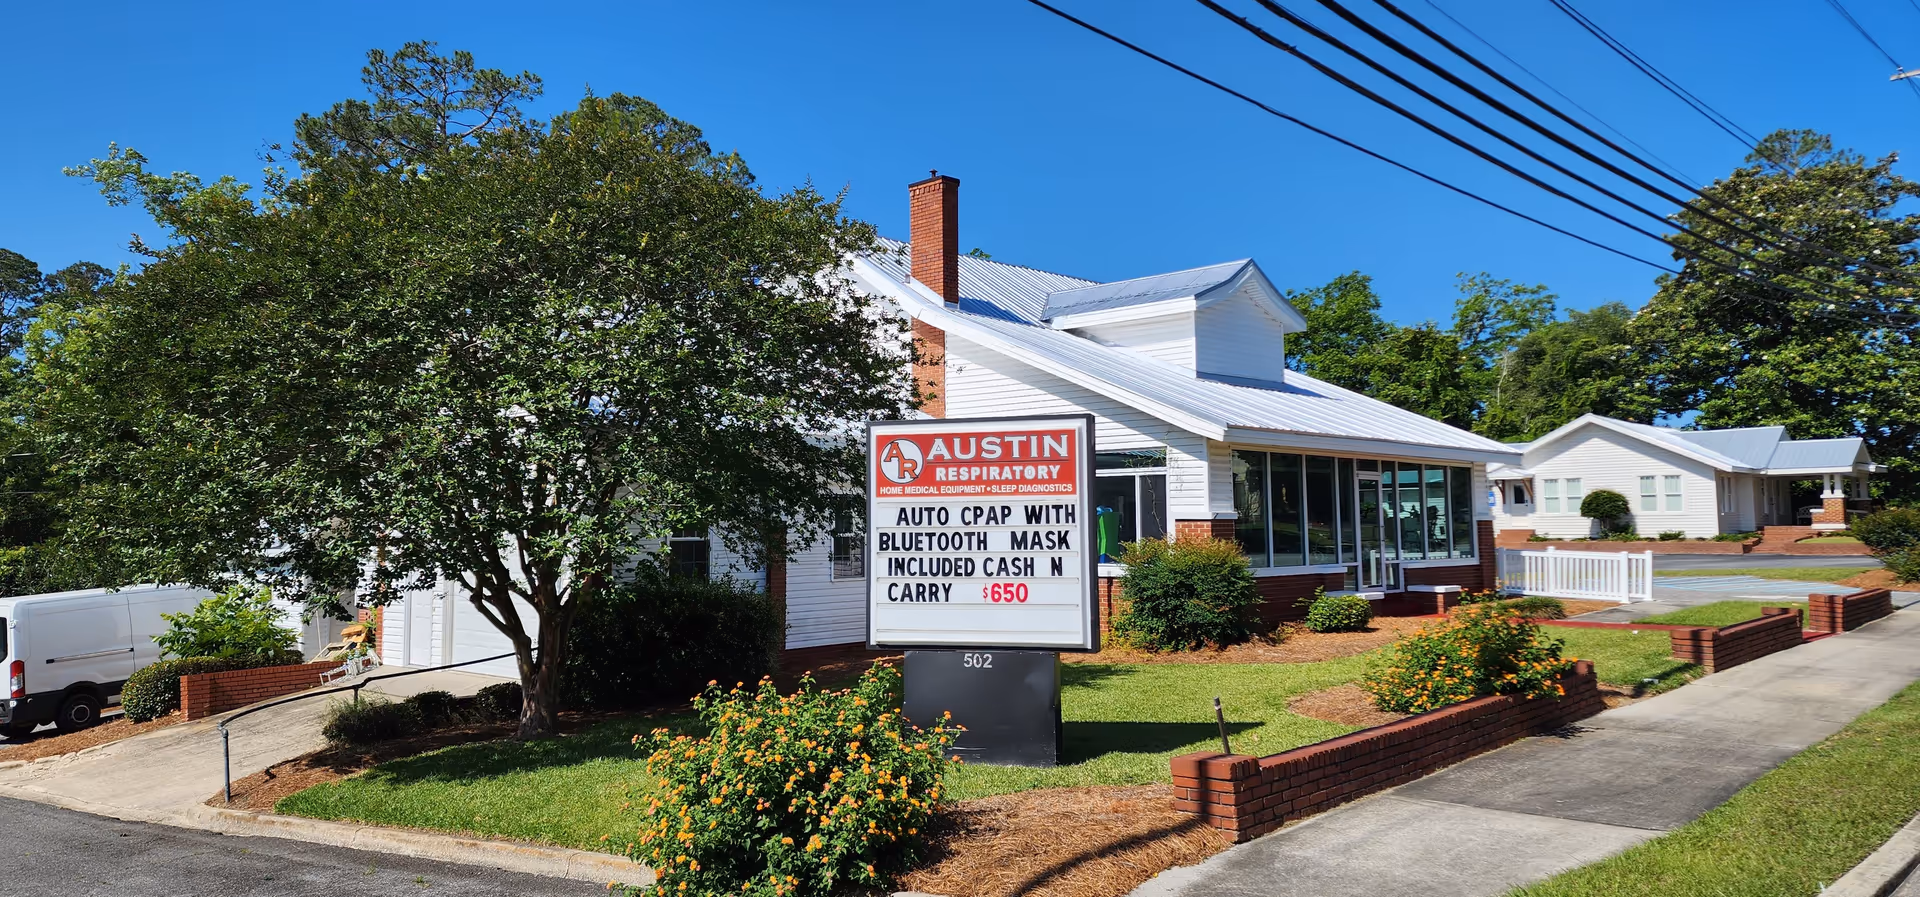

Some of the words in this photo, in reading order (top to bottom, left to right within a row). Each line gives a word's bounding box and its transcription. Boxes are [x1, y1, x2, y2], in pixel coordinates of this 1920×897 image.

[926, 434, 1068, 460] AUSTIN
[936, 464, 1060, 481] RESPIRATORY
[880, 486, 903, 494] HOME
[904, 485, 939, 494] MEDICAL
[940, 485, 985, 494] EQUIPMENT
[991, 484, 1017, 493] SLEEP
[1018, 483, 1072, 493] DIAGNOSTICS
[896, 507, 949, 526] AUTO
[961, 506, 1012, 525] CPAP
[1024, 504, 1076, 524] WITH
[879, 532, 987, 551] BLUETOOTH
[1010, 530, 1070, 550] MASK
[888, 557, 975, 577] INCLUDED
[983, 557, 1034, 577] CASH
[1051, 556, 1063, 576] N
[888, 583, 952, 602] CARRY
[983, 583, 1028, 603] $650
[963, 653, 993, 668] 502
